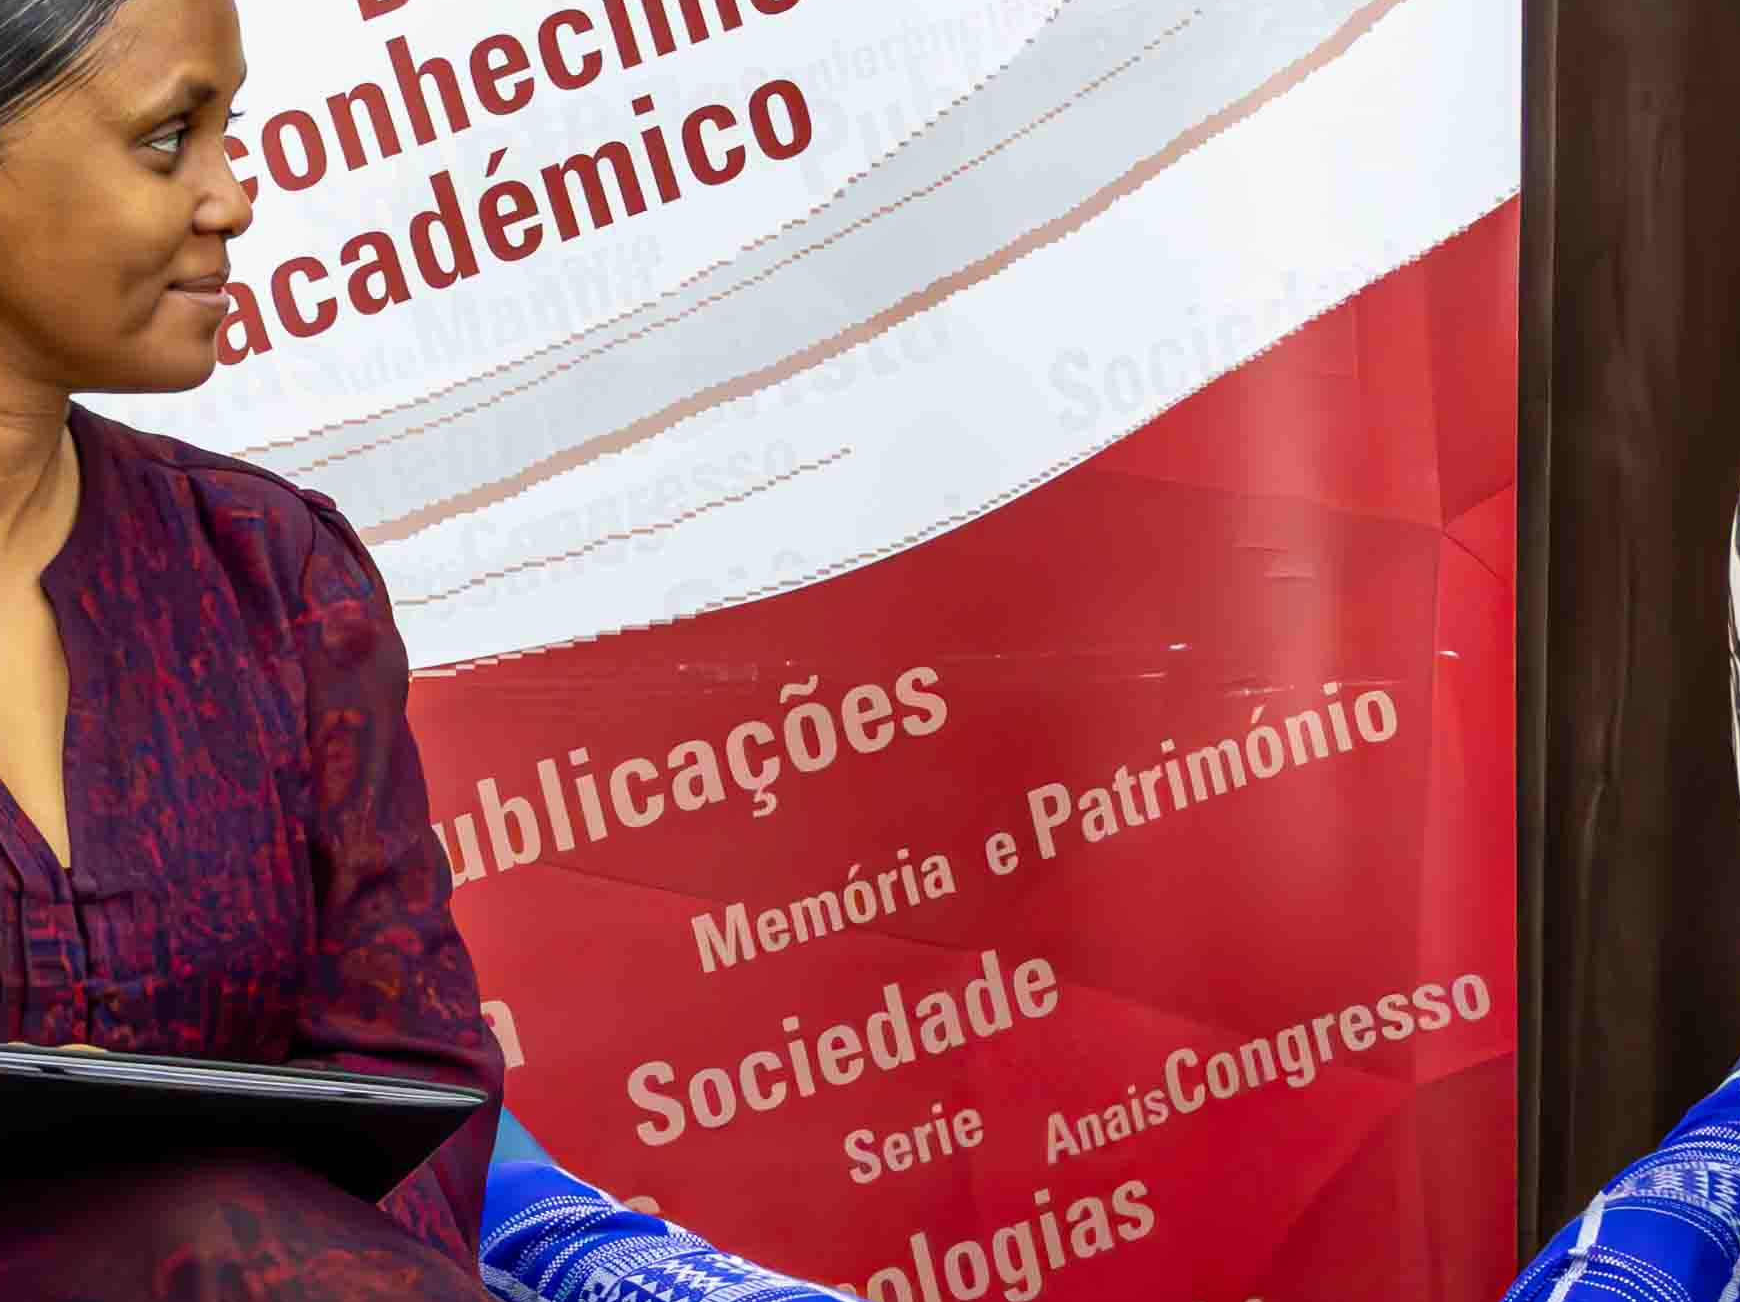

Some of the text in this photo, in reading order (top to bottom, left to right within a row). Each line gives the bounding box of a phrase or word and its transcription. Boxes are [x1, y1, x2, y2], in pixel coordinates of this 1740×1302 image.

[215, 78, 814, 366] académico
[689, 688, 1400, 975] Memória e Património
[625, 948, 1061, 1148] Sociedade
[841, 1101, 985, 1186] Serie
